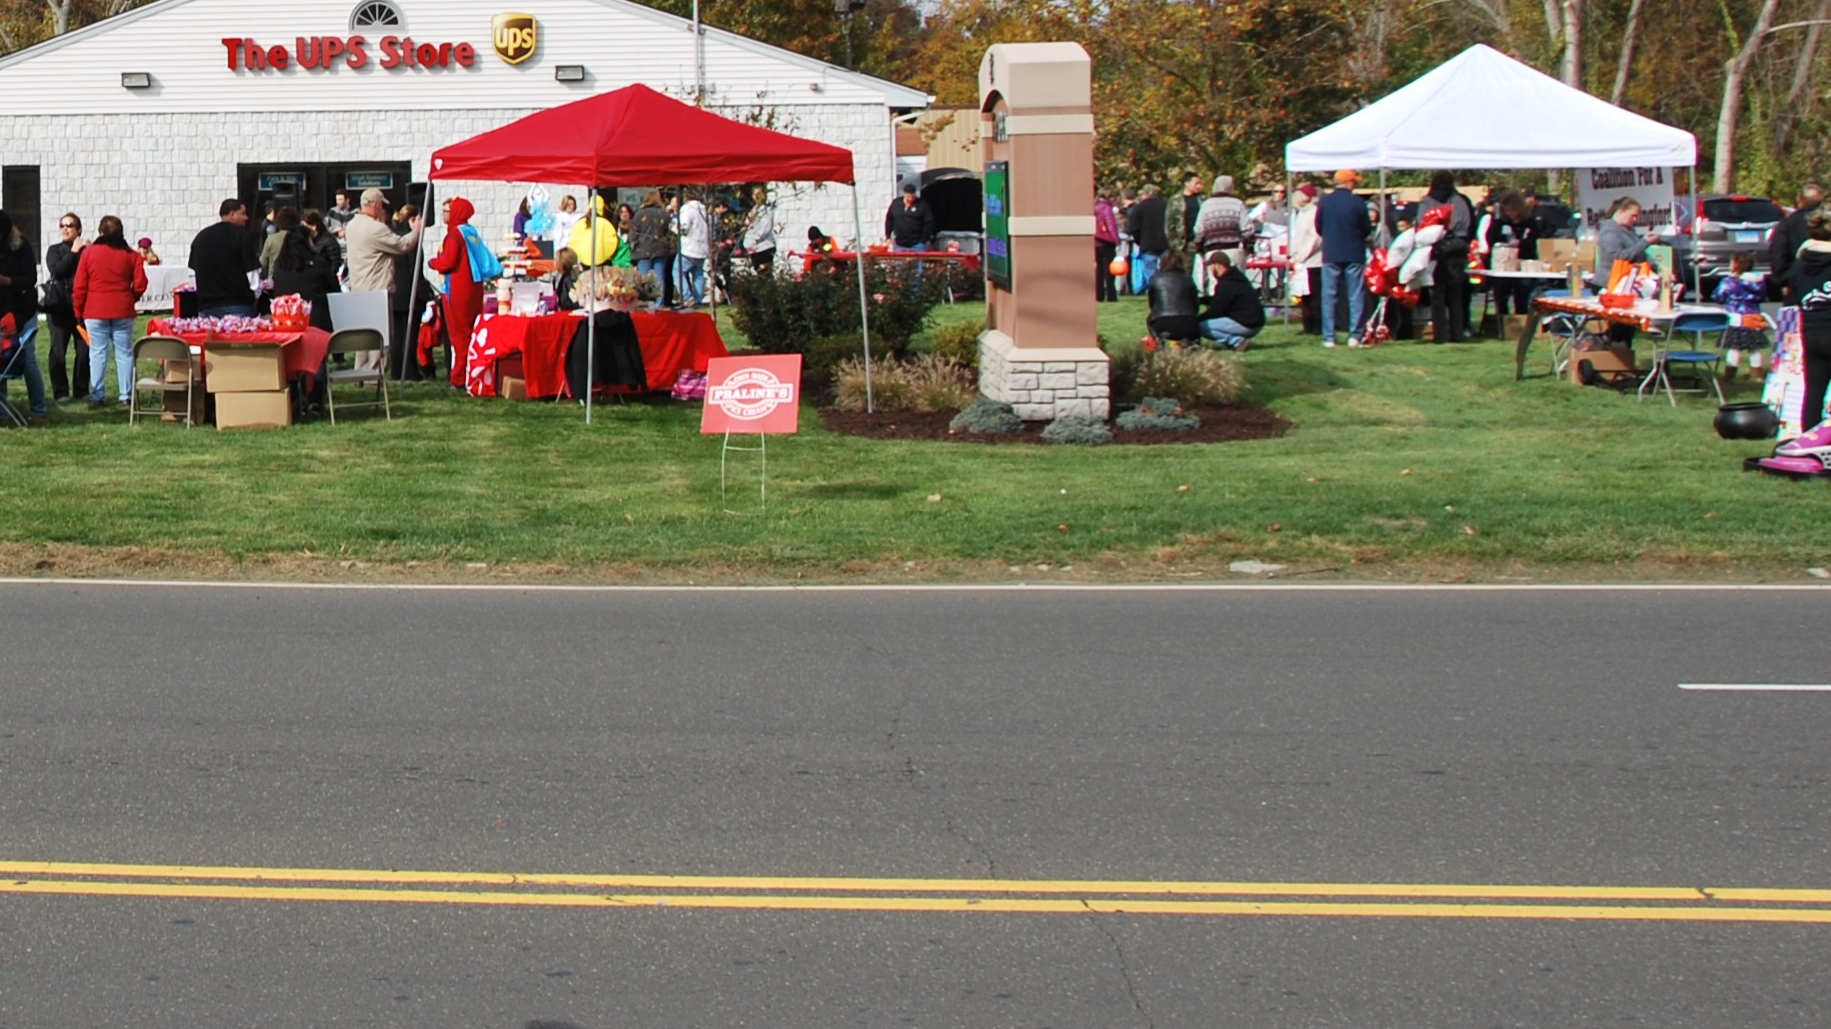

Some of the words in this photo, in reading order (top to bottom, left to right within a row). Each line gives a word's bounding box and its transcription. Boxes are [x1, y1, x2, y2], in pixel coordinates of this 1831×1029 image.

[221, 37, 289, 71] The
[295, 35, 369, 69] UPS
[379, 35, 476, 69] Store
[495, 27, 533, 56] ups
[714, 388, 788, 400] PRALINE'S
